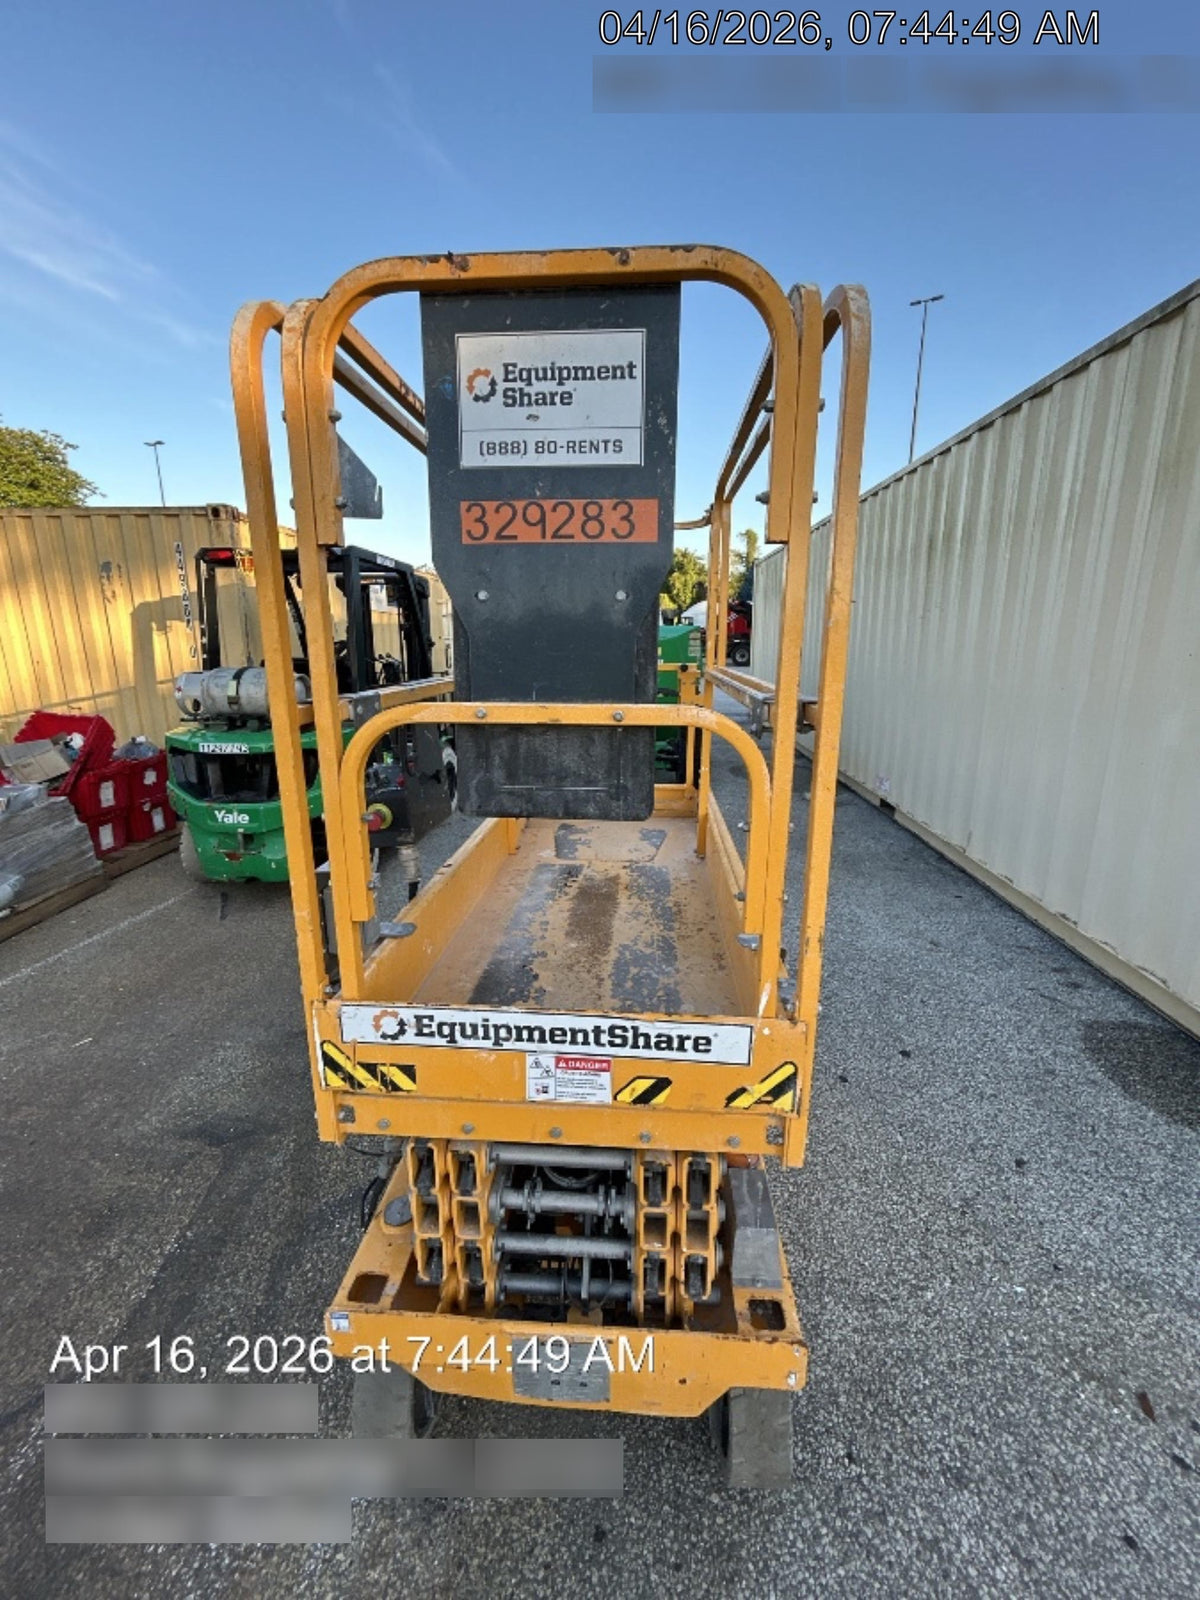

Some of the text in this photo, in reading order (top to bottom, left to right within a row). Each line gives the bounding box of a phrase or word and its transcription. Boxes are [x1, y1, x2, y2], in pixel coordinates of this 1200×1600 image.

[502, 361, 637, 386] Equipment
[502, 387, 574, 408] Share
[479, 438, 623, 456] (888) 80-RENTS
[465, 500, 636, 541] 329283
[214, 810, 250, 824] Yale
[413, 1014, 713, 1053] EquipmentShare
[568, 1060, 609, 1071] DANGER
